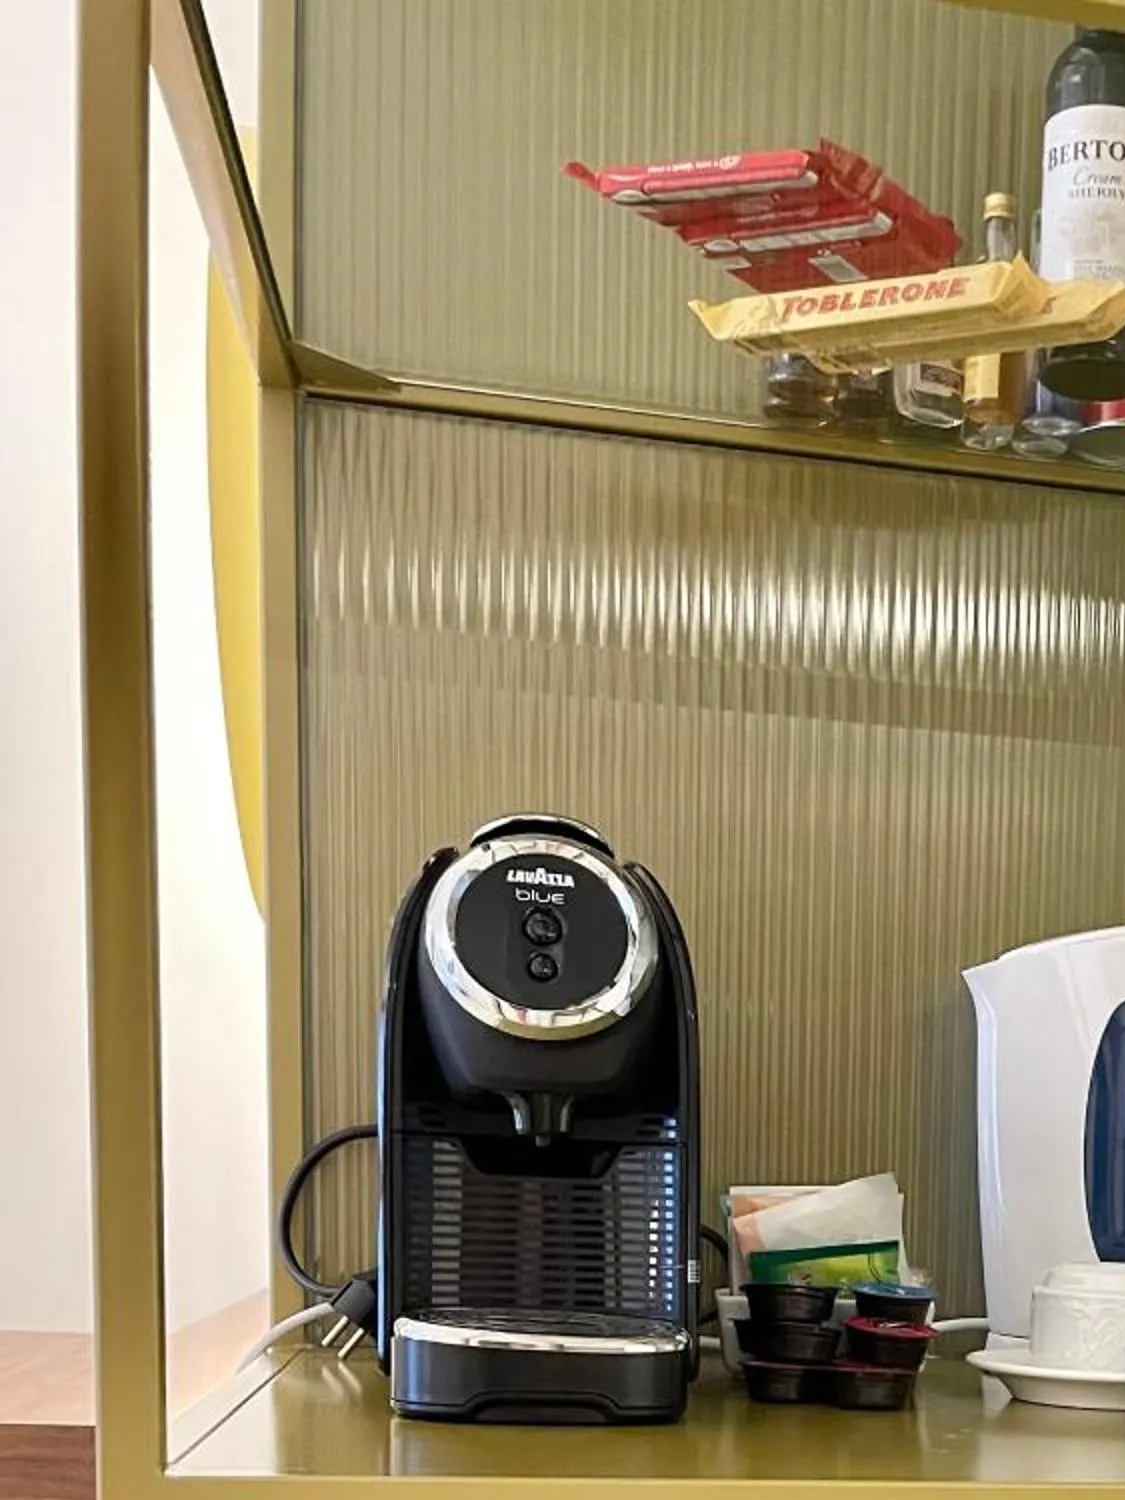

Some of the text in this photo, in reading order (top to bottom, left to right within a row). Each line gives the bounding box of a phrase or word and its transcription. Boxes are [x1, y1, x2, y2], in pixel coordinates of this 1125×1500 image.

[780, 276, 970, 324] TOBLERONE
[506, 866, 575, 889] LAVAZZA
[515, 887, 566, 905] blue
